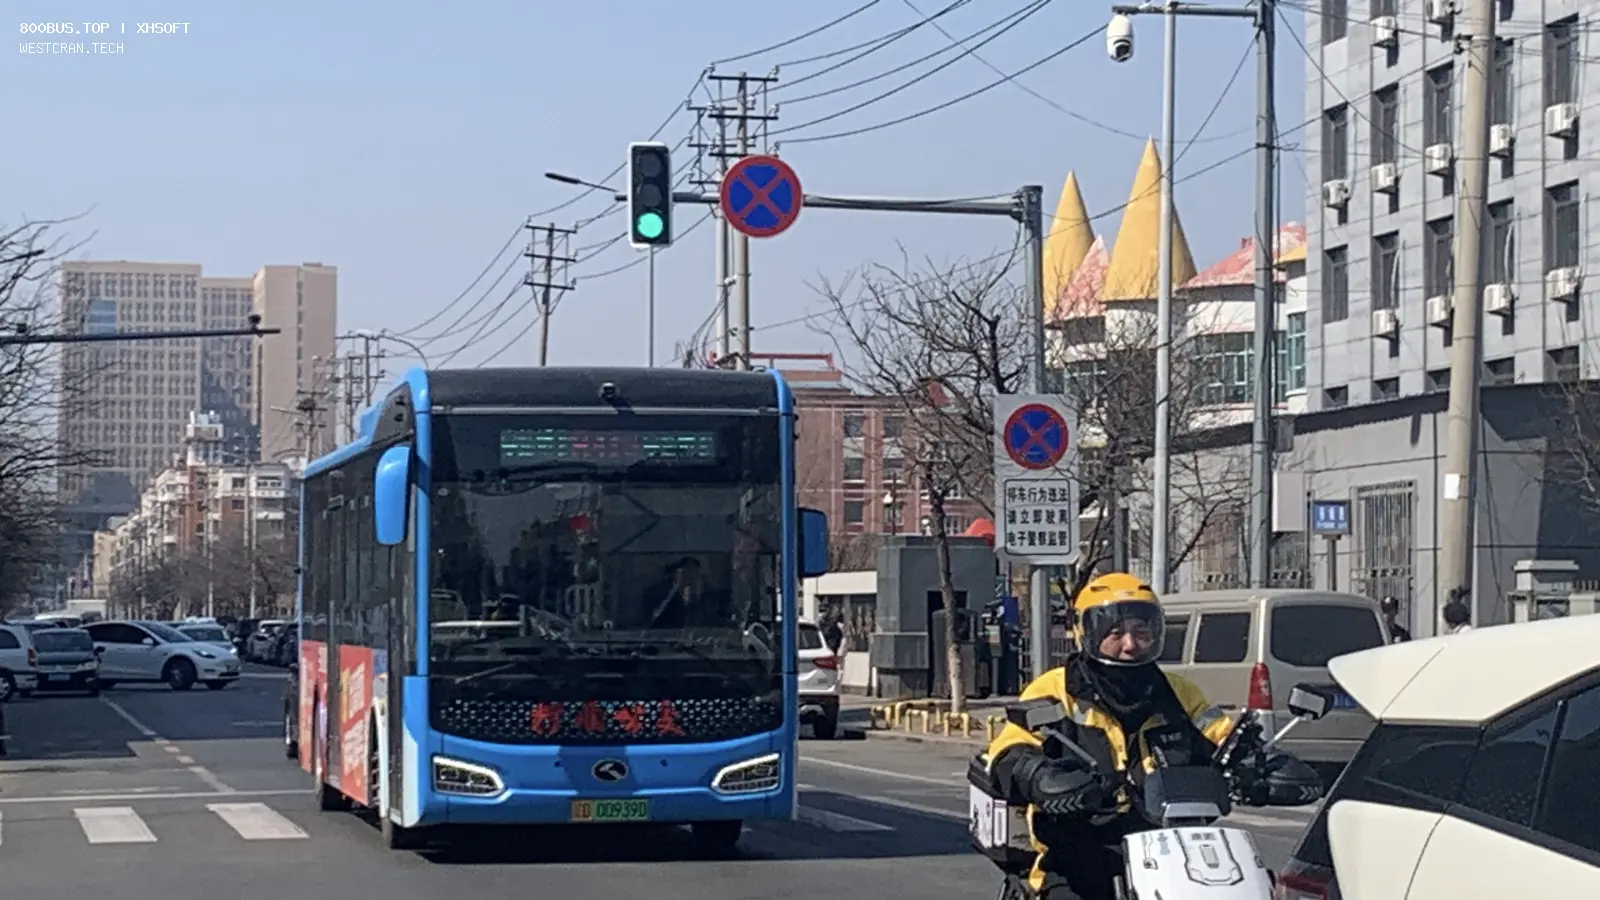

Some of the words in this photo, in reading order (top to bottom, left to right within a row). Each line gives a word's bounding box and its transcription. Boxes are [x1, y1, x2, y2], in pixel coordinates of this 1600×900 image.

[1007, 486, 1068, 503] 停车行为违法
[1007, 508, 1068, 525] 请立即驶离
[1007, 530, 1067, 547] 电子警察监管
